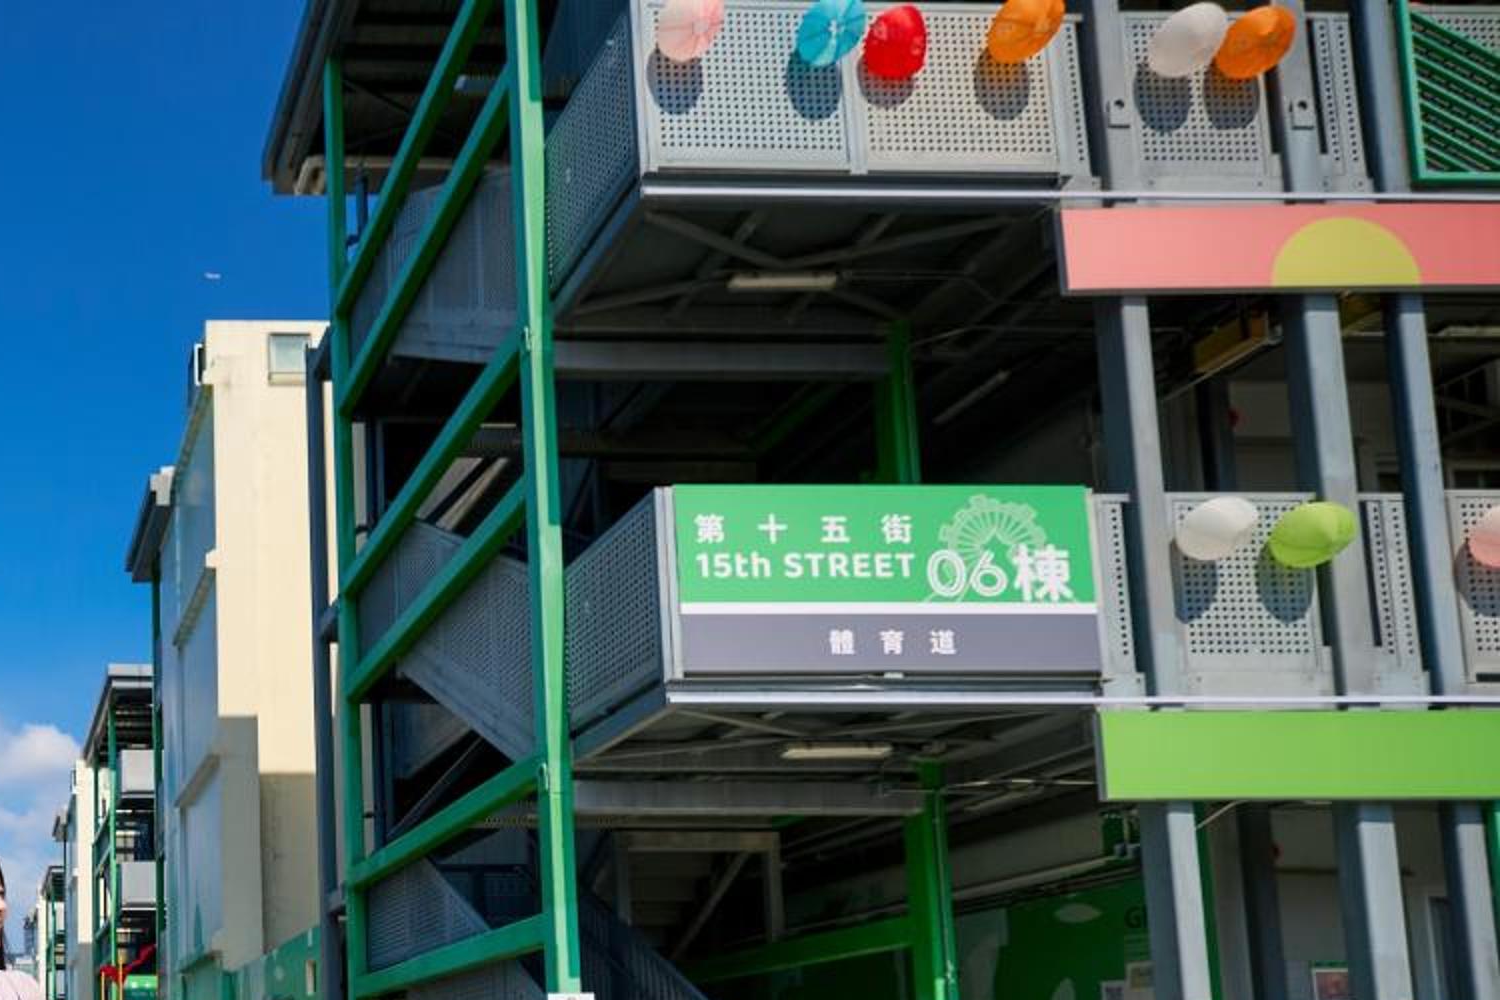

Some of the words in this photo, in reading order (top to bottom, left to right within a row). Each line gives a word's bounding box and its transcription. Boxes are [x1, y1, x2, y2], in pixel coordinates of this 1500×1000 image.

[695, 513, 913, 544] 第十五街
[696, 552, 771, 578] 15th
[785, 552, 915, 578] STREET
[927, 543, 1072, 602] 06棟
[829, 629, 956, 655] 體育道
